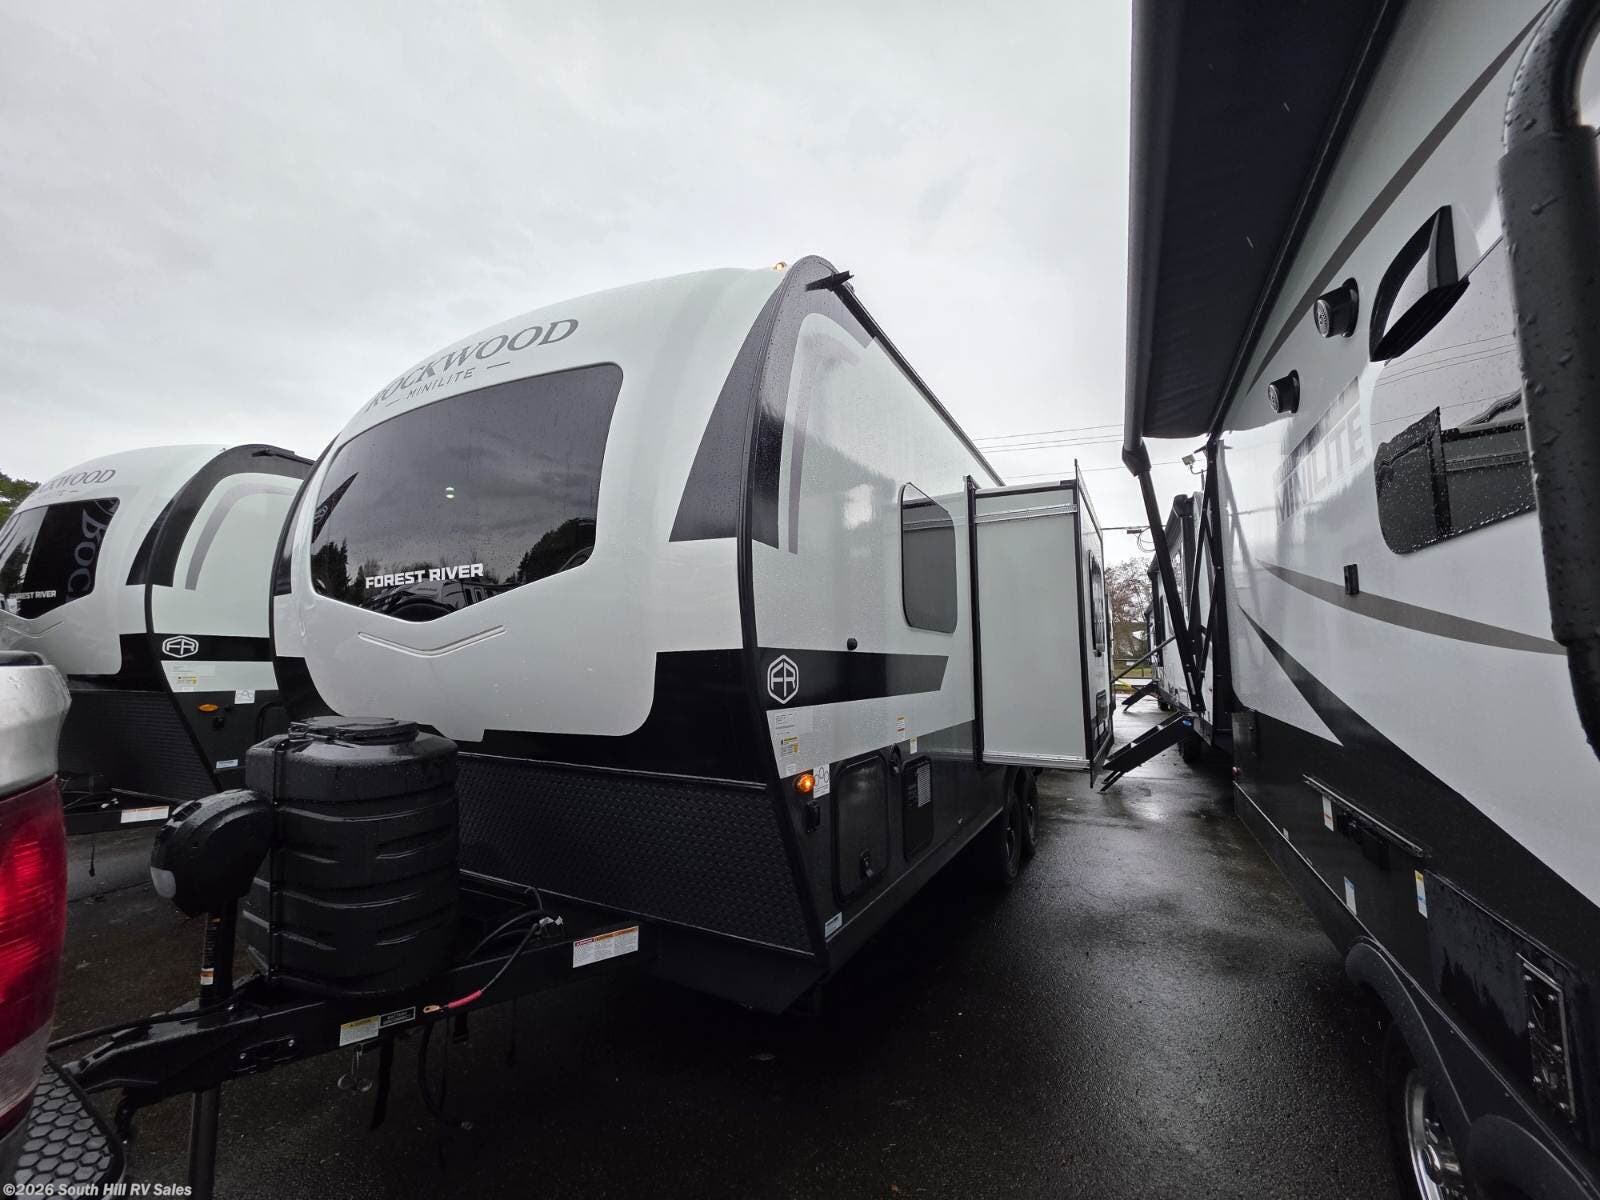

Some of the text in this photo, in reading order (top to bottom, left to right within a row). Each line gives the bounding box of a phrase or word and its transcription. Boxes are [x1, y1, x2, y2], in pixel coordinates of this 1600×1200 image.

[406, 367, 477, 400] MINILITE
[365, 562, 484, 589] FOREST RIVER
[35, 590, 57, 599] RIVER
